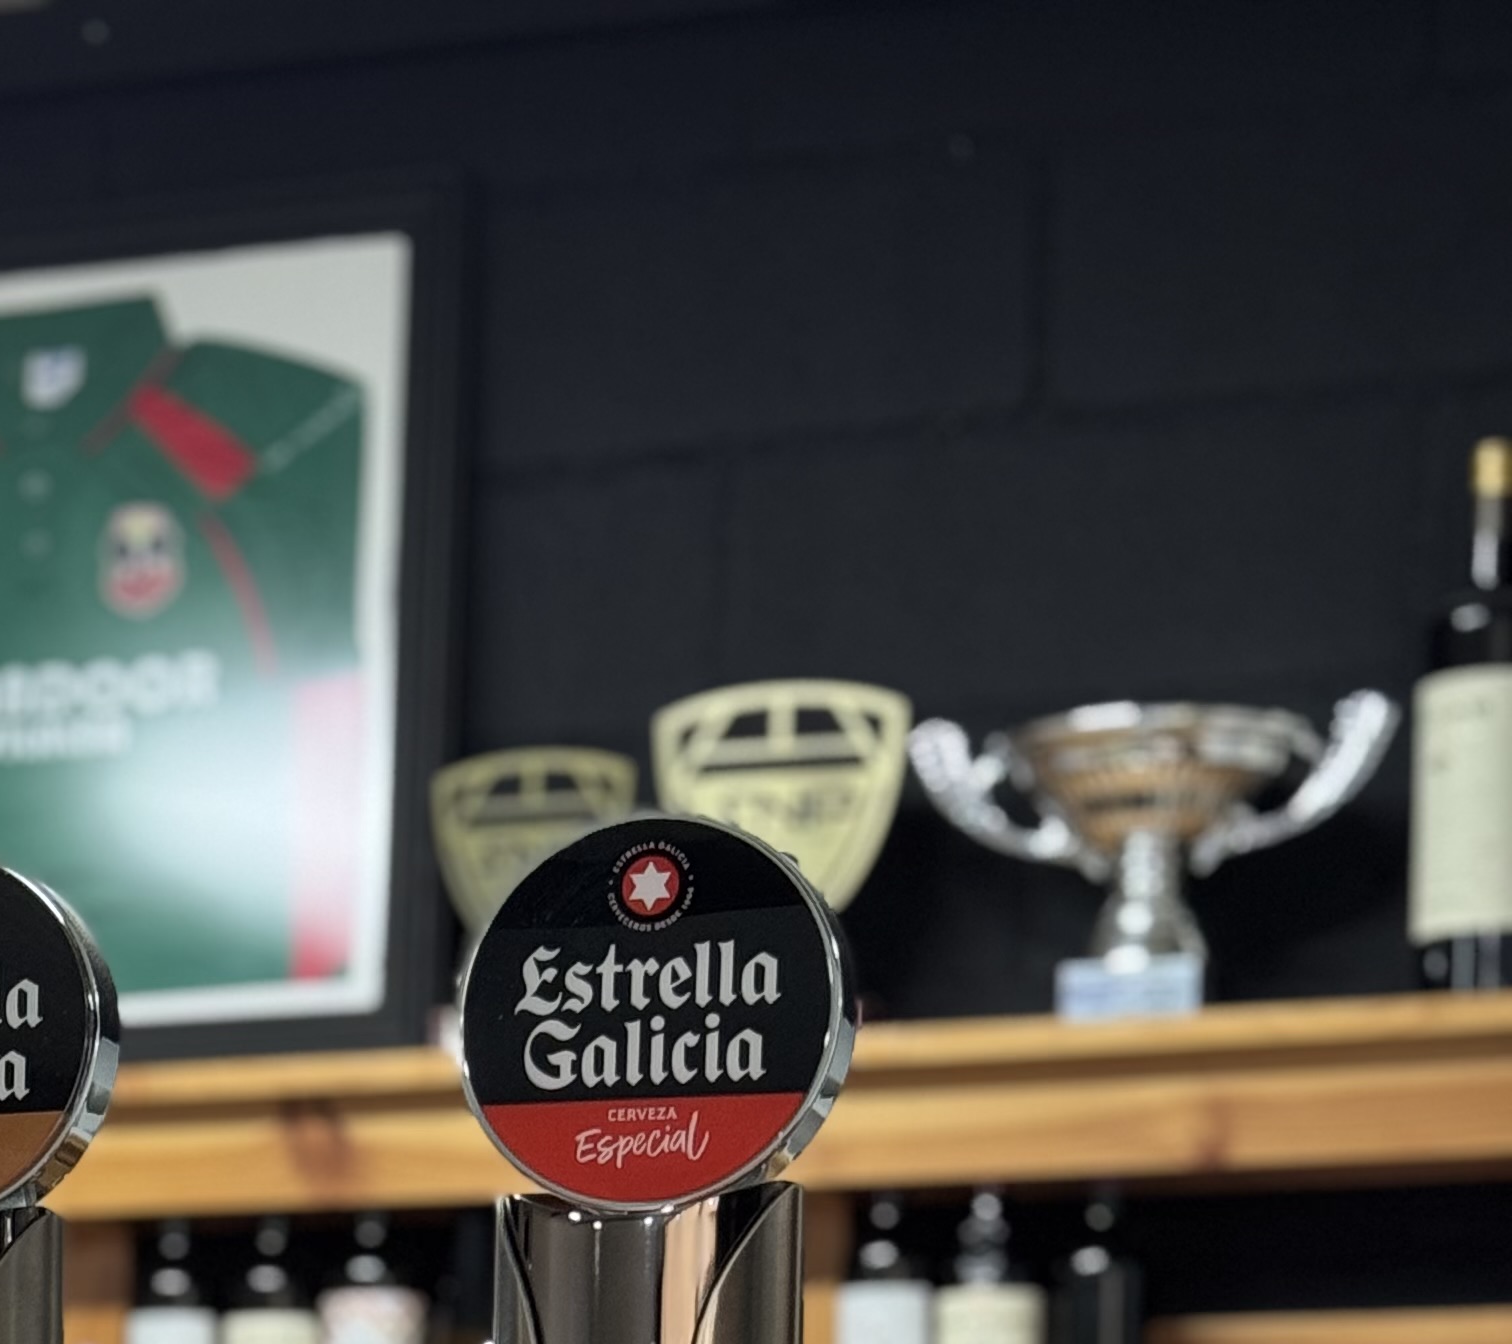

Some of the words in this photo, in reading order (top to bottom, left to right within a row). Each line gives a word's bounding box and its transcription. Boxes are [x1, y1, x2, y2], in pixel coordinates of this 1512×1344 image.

[612, 841, 655, 874] ESTRELLA
[658, 841, 690, 871] GALICIA
[513, 939, 782, 1017] Estrella
[524, 1013, 766, 1090] Galicia
[575, 1110, 710, 1169] Especial
[608, 1107, 677, 1122] CERVEZA
